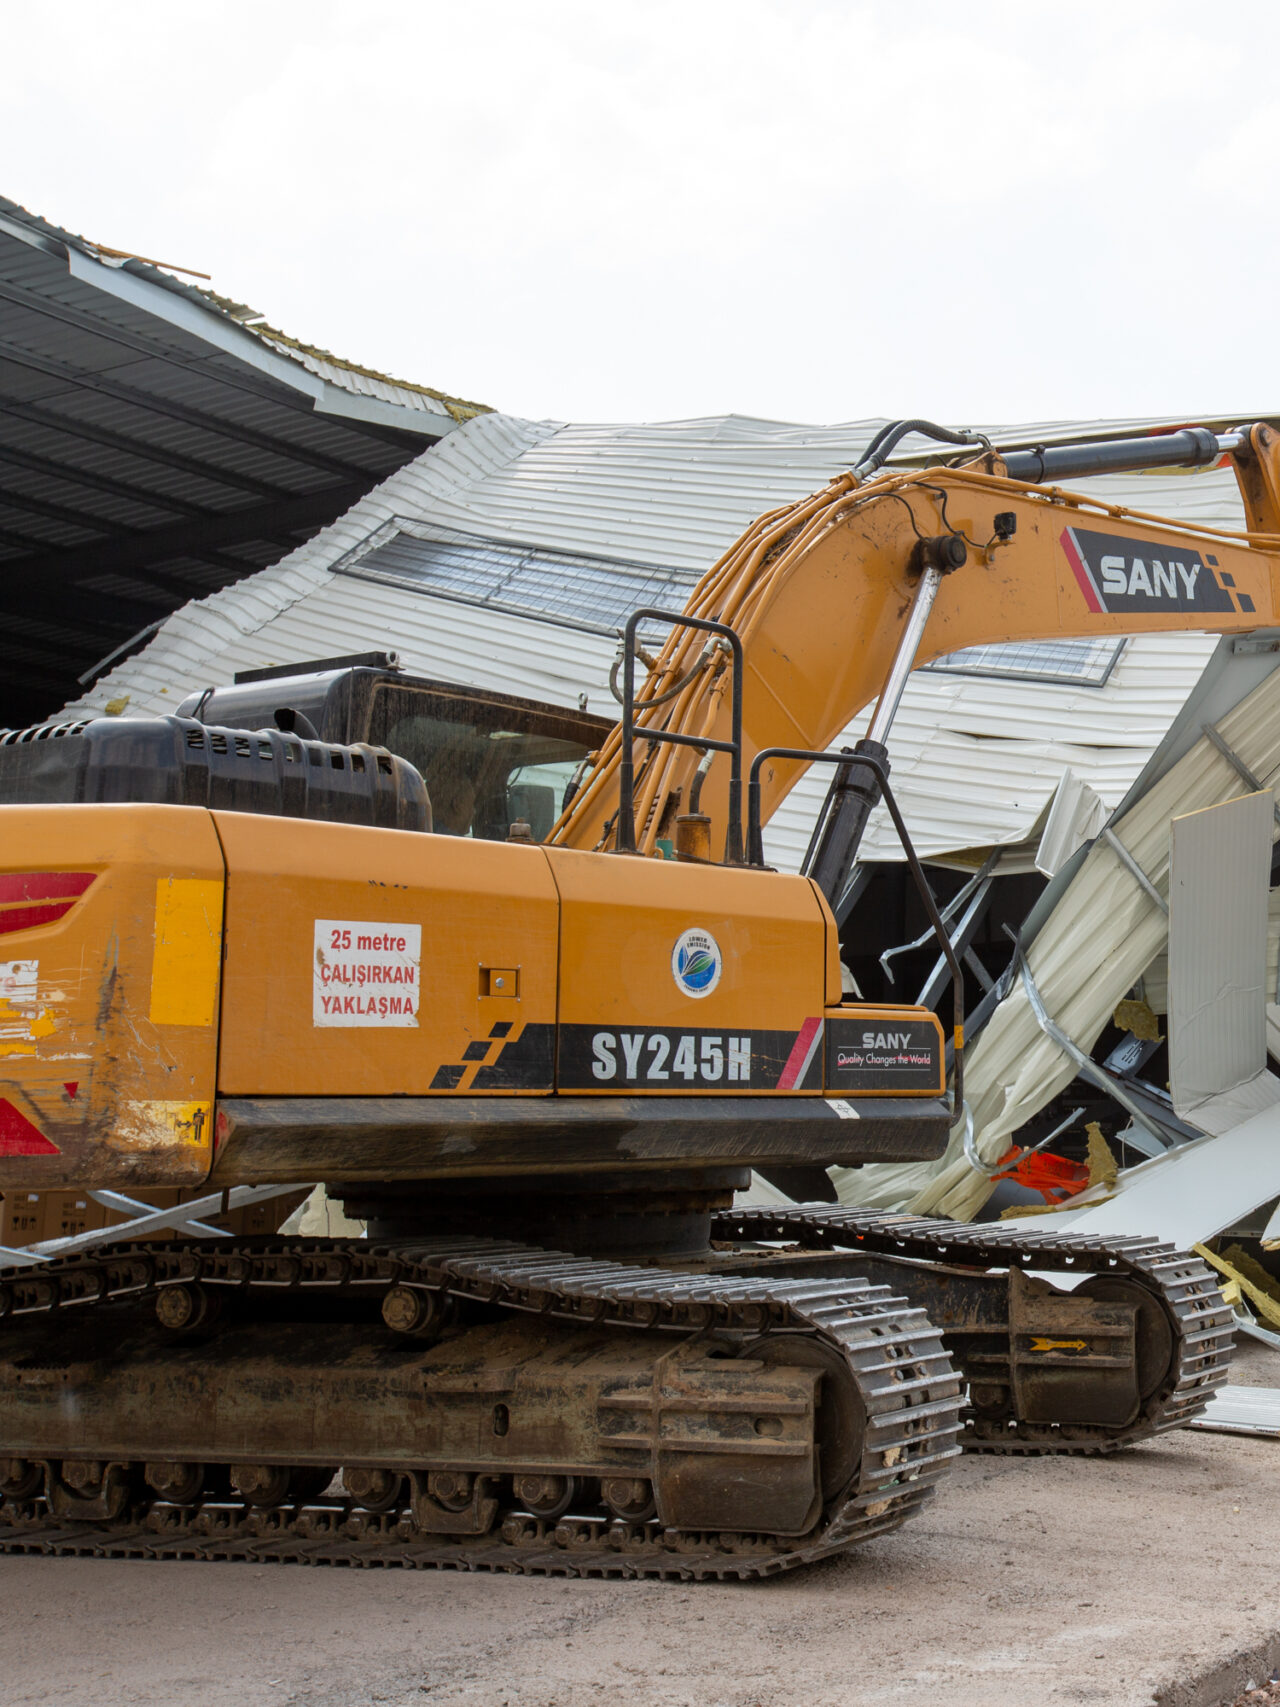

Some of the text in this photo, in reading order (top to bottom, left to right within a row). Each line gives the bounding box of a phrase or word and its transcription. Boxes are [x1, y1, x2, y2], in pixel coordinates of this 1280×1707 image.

[1100, 555, 1201, 600] SANY
[331, 929, 406, 952] 25 metre
[320, 964, 414, 987] ÇALIŞIRKAN
[321, 995, 414, 1019] YAKLAŞMA
[862, 1032, 911, 1049] SANY
[591, 1031, 752, 1081] SY245H
[838, 1052, 930, 1067] Quality Changes the World
